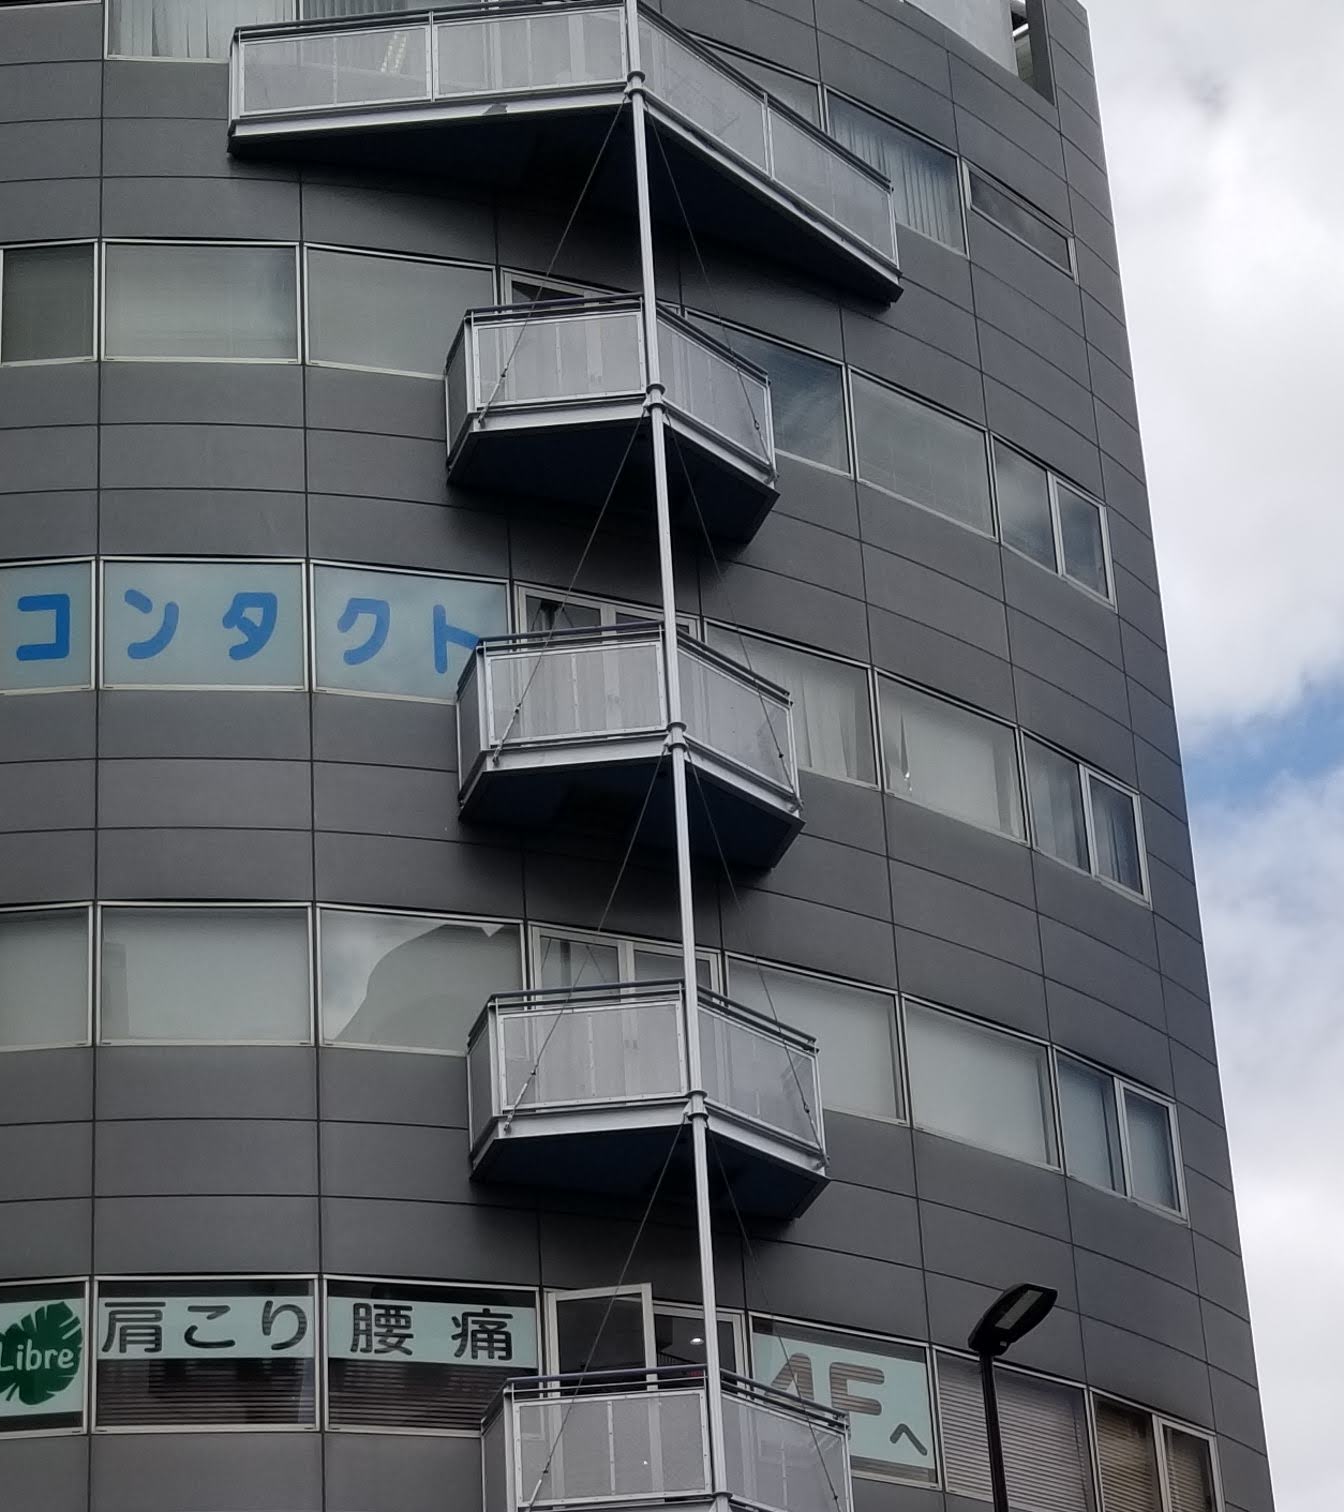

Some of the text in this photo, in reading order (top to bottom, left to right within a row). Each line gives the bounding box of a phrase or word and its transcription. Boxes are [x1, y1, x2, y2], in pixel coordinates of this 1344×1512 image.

[17, 589, 479, 674] コンタクト
[102, 1301, 514, 1361] 肩こり 腰痛
